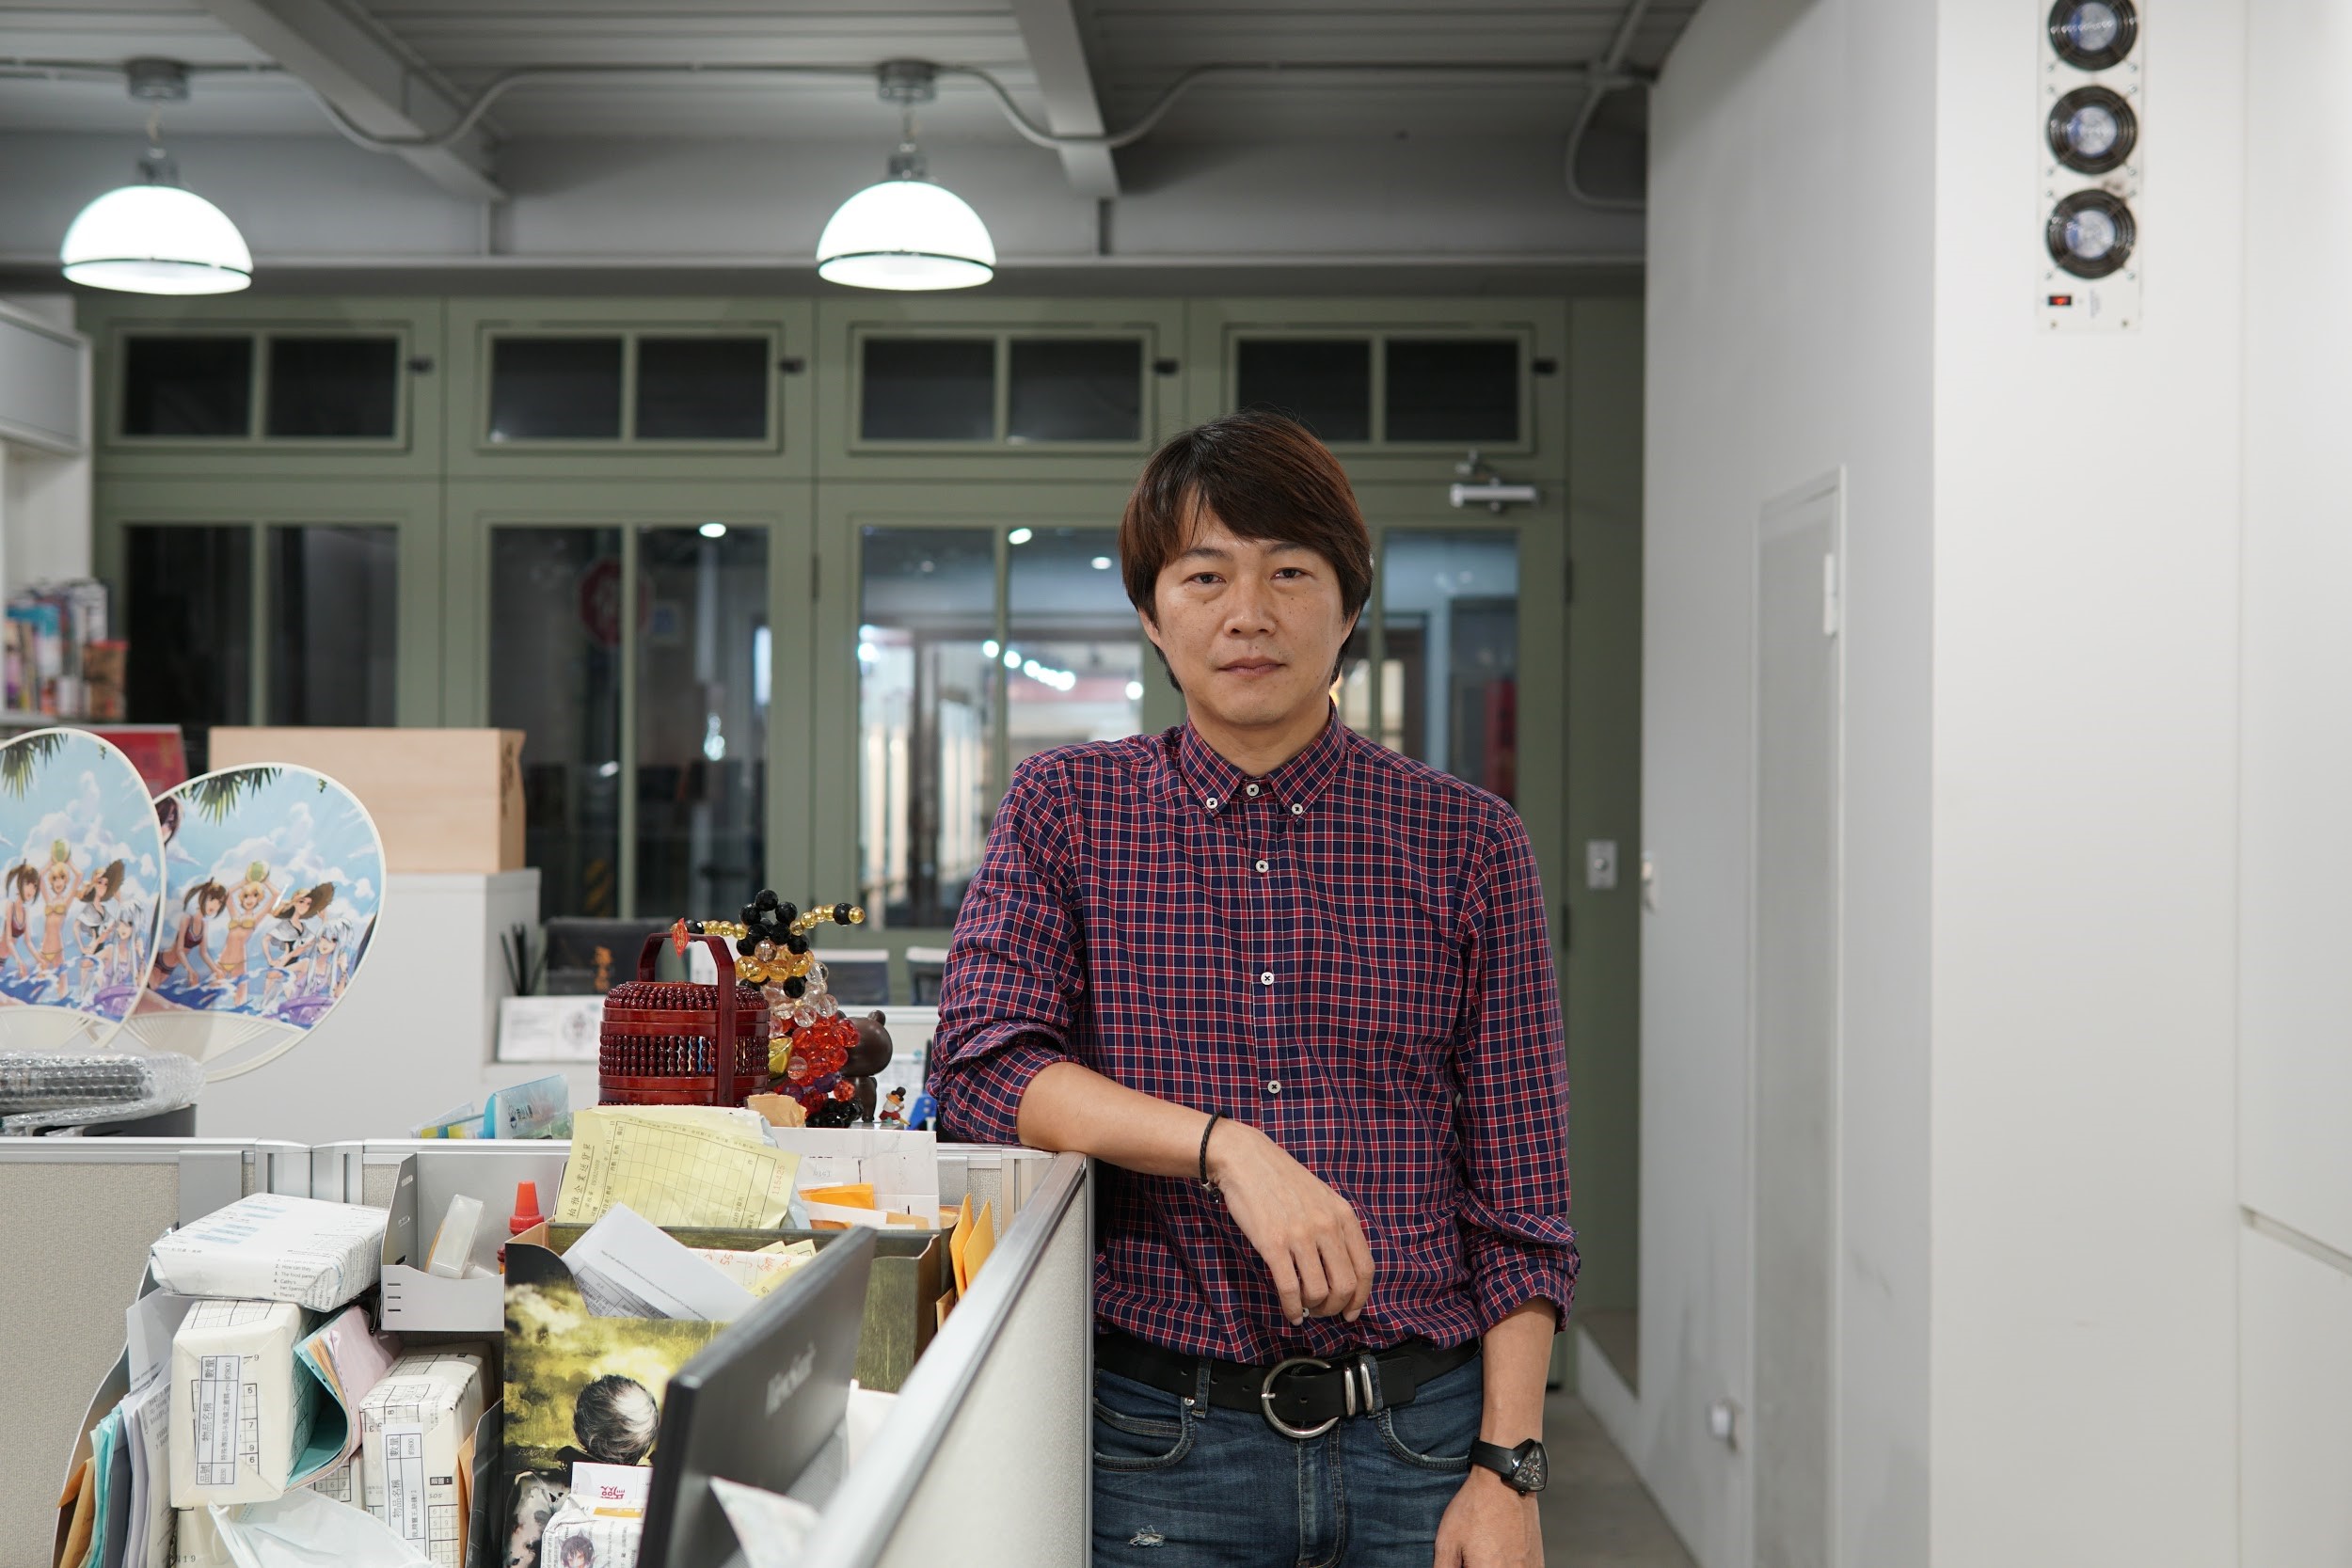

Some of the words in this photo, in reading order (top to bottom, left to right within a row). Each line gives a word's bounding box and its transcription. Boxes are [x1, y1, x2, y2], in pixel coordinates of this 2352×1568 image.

[204, 1358, 215, 1379] 數量
[200, 1402, 214, 1442] 物品名稱
[389, 1436, 400, 1457] 數量
[199, 1464, 211, 1483] 品號
[390, 1479, 403, 1518] 物品名稱
